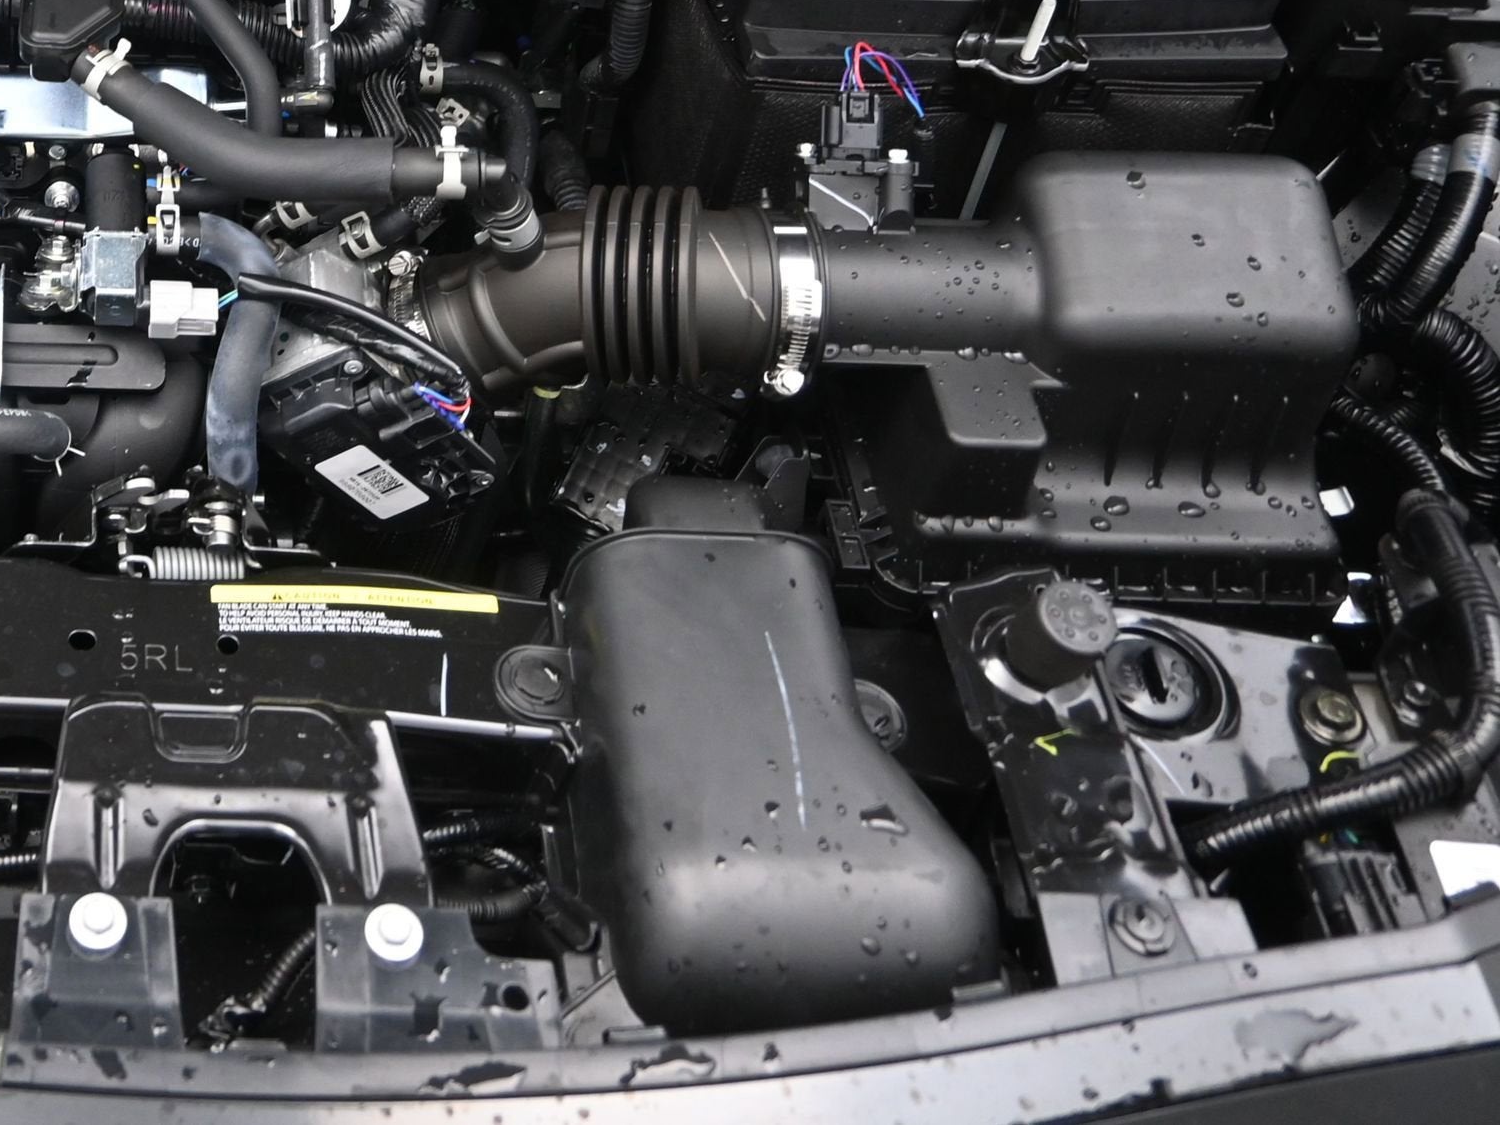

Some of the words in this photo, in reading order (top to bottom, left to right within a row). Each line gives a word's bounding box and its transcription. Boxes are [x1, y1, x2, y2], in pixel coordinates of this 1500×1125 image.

[325, 610, 341, 618] KEEP
[341, 610, 364, 619] HANDS
[359, 618, 377, 626] TOUT
[219, 624, 239, 632] POUR
[265, 624, 288, 632] TOUTE
[362, 626, 404, 635] APPROCHER
[120, 643, 193, 671] 5RL
